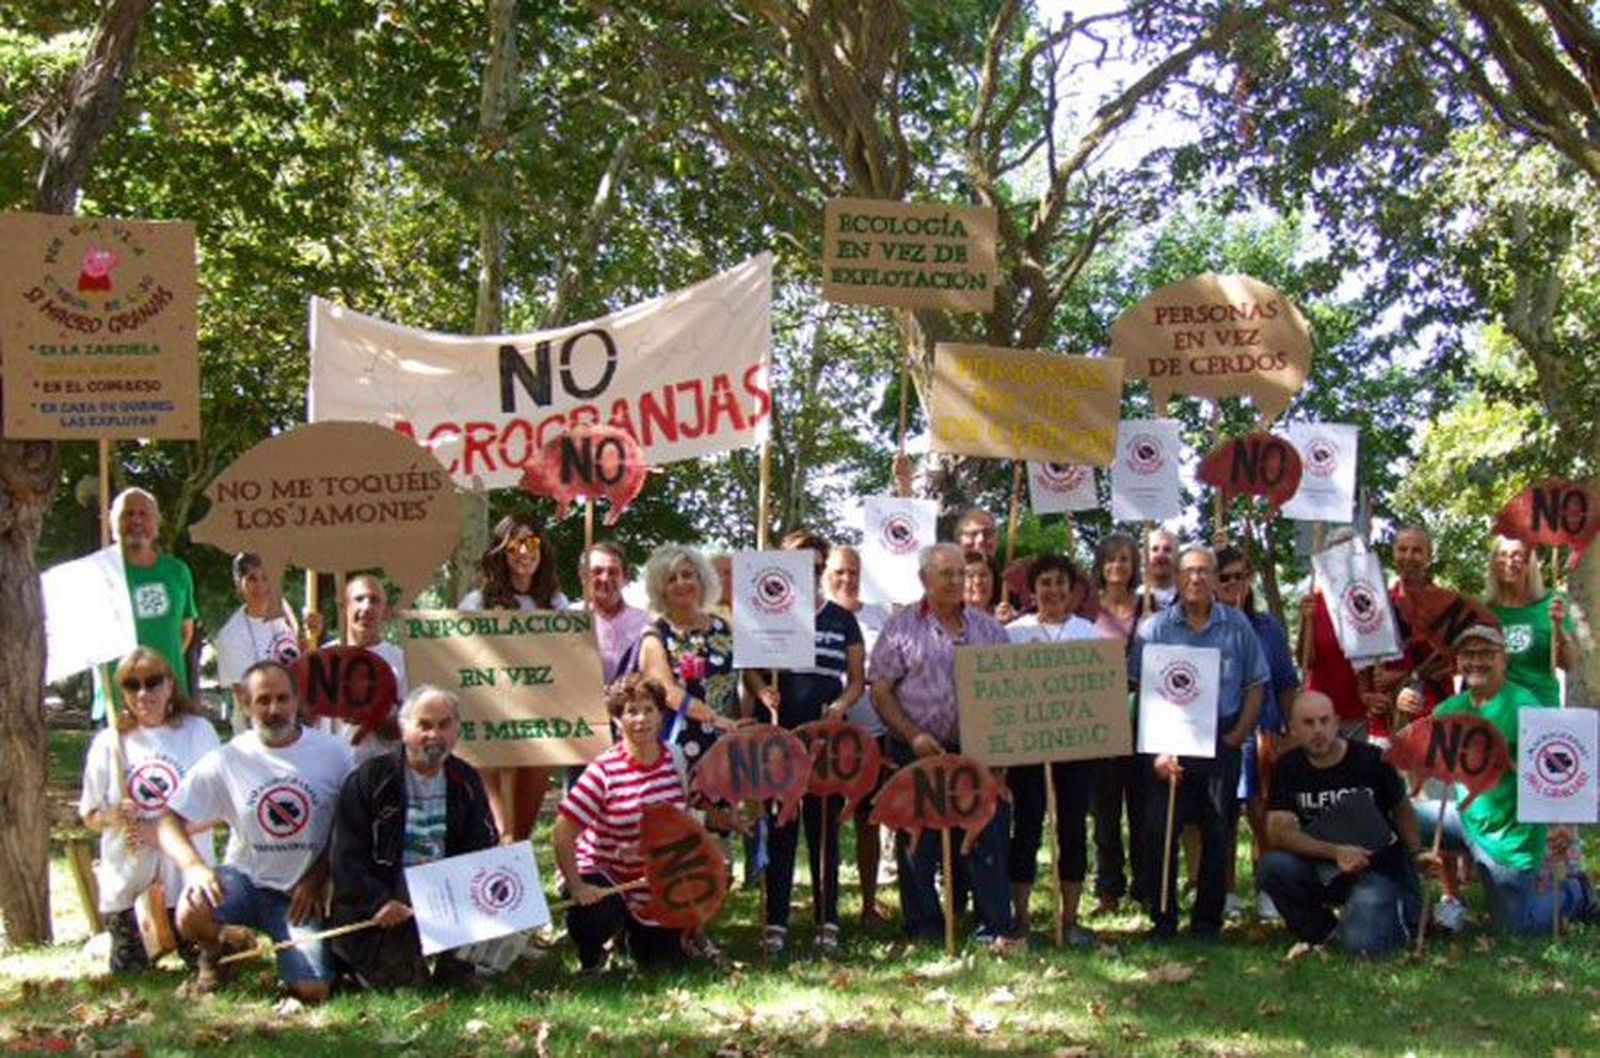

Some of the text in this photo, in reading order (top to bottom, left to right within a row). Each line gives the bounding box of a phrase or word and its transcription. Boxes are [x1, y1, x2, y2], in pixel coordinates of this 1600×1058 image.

[839, 212, 968, 238] ECOLOGÍA
[836, 240, 968, 264] EN VEZ DE
[831, 267, 988, 291] EXPLOTACIÓN
[1154, 301, 1279, 326] PERSONAS
[1173, 329, 1262, 352] EN VEZ
[499, 329, 617, 413] NO
[1148, 351, 1289, 378] DE CERDOS
[393, 364, 768, 475] CROGANJAS
[216, 462, 442, 502] NO ME TOQUÉIS
[560, 437, 626, 485] NO
[1229, 440, 1286, 487] NO
[235, 508, 285, 531] LOS
[1531, 488, 1588, 535] NO
[306, 653, 378, 707] NO
[459, 665, 554, 688] EN VEZ
[459, 716, 595, 741] E MIERDA
[1425, 720, 1494, 776] NO
[727, 736, 792, 794] NO
[911, 764, 981, 818] NO
[652, 832, 717, 908] NO
